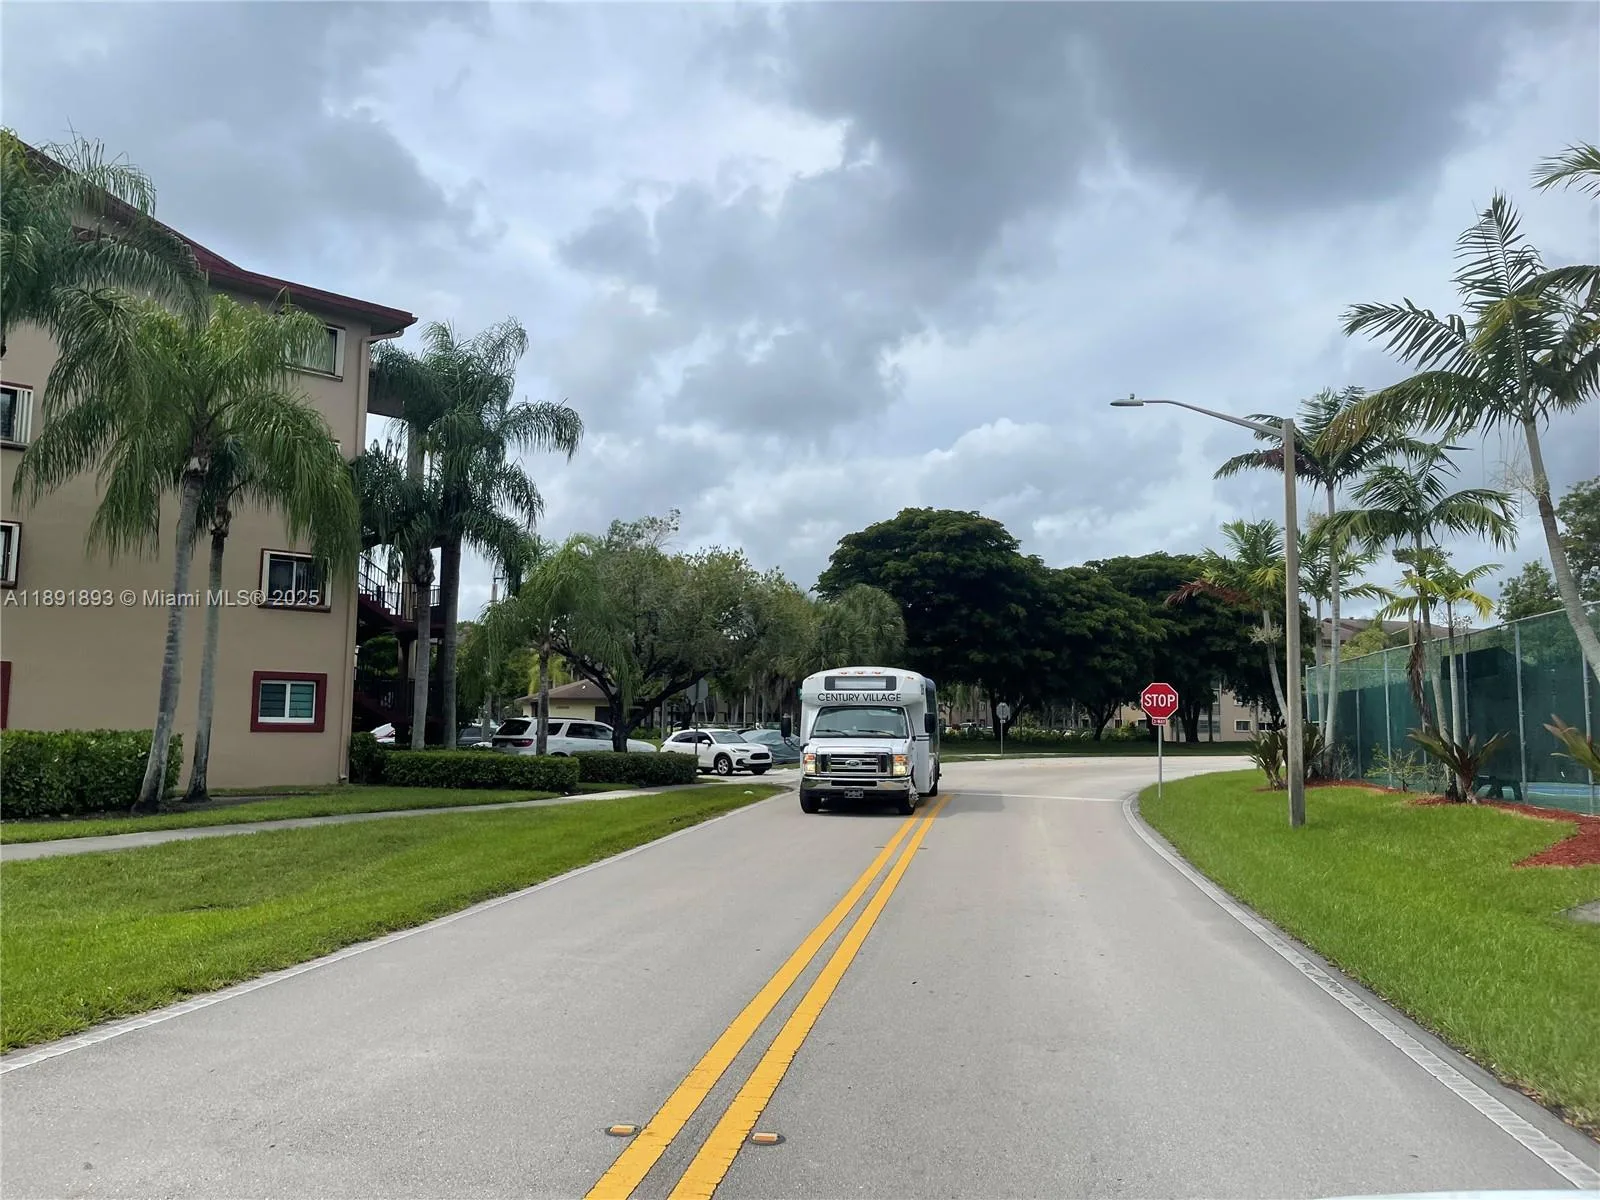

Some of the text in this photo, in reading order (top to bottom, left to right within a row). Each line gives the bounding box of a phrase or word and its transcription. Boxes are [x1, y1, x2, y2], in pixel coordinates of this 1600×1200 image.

[817, 692, 902, 702] CENTURY VILLAGE
[1144, 694, 1176, 707] STOP
